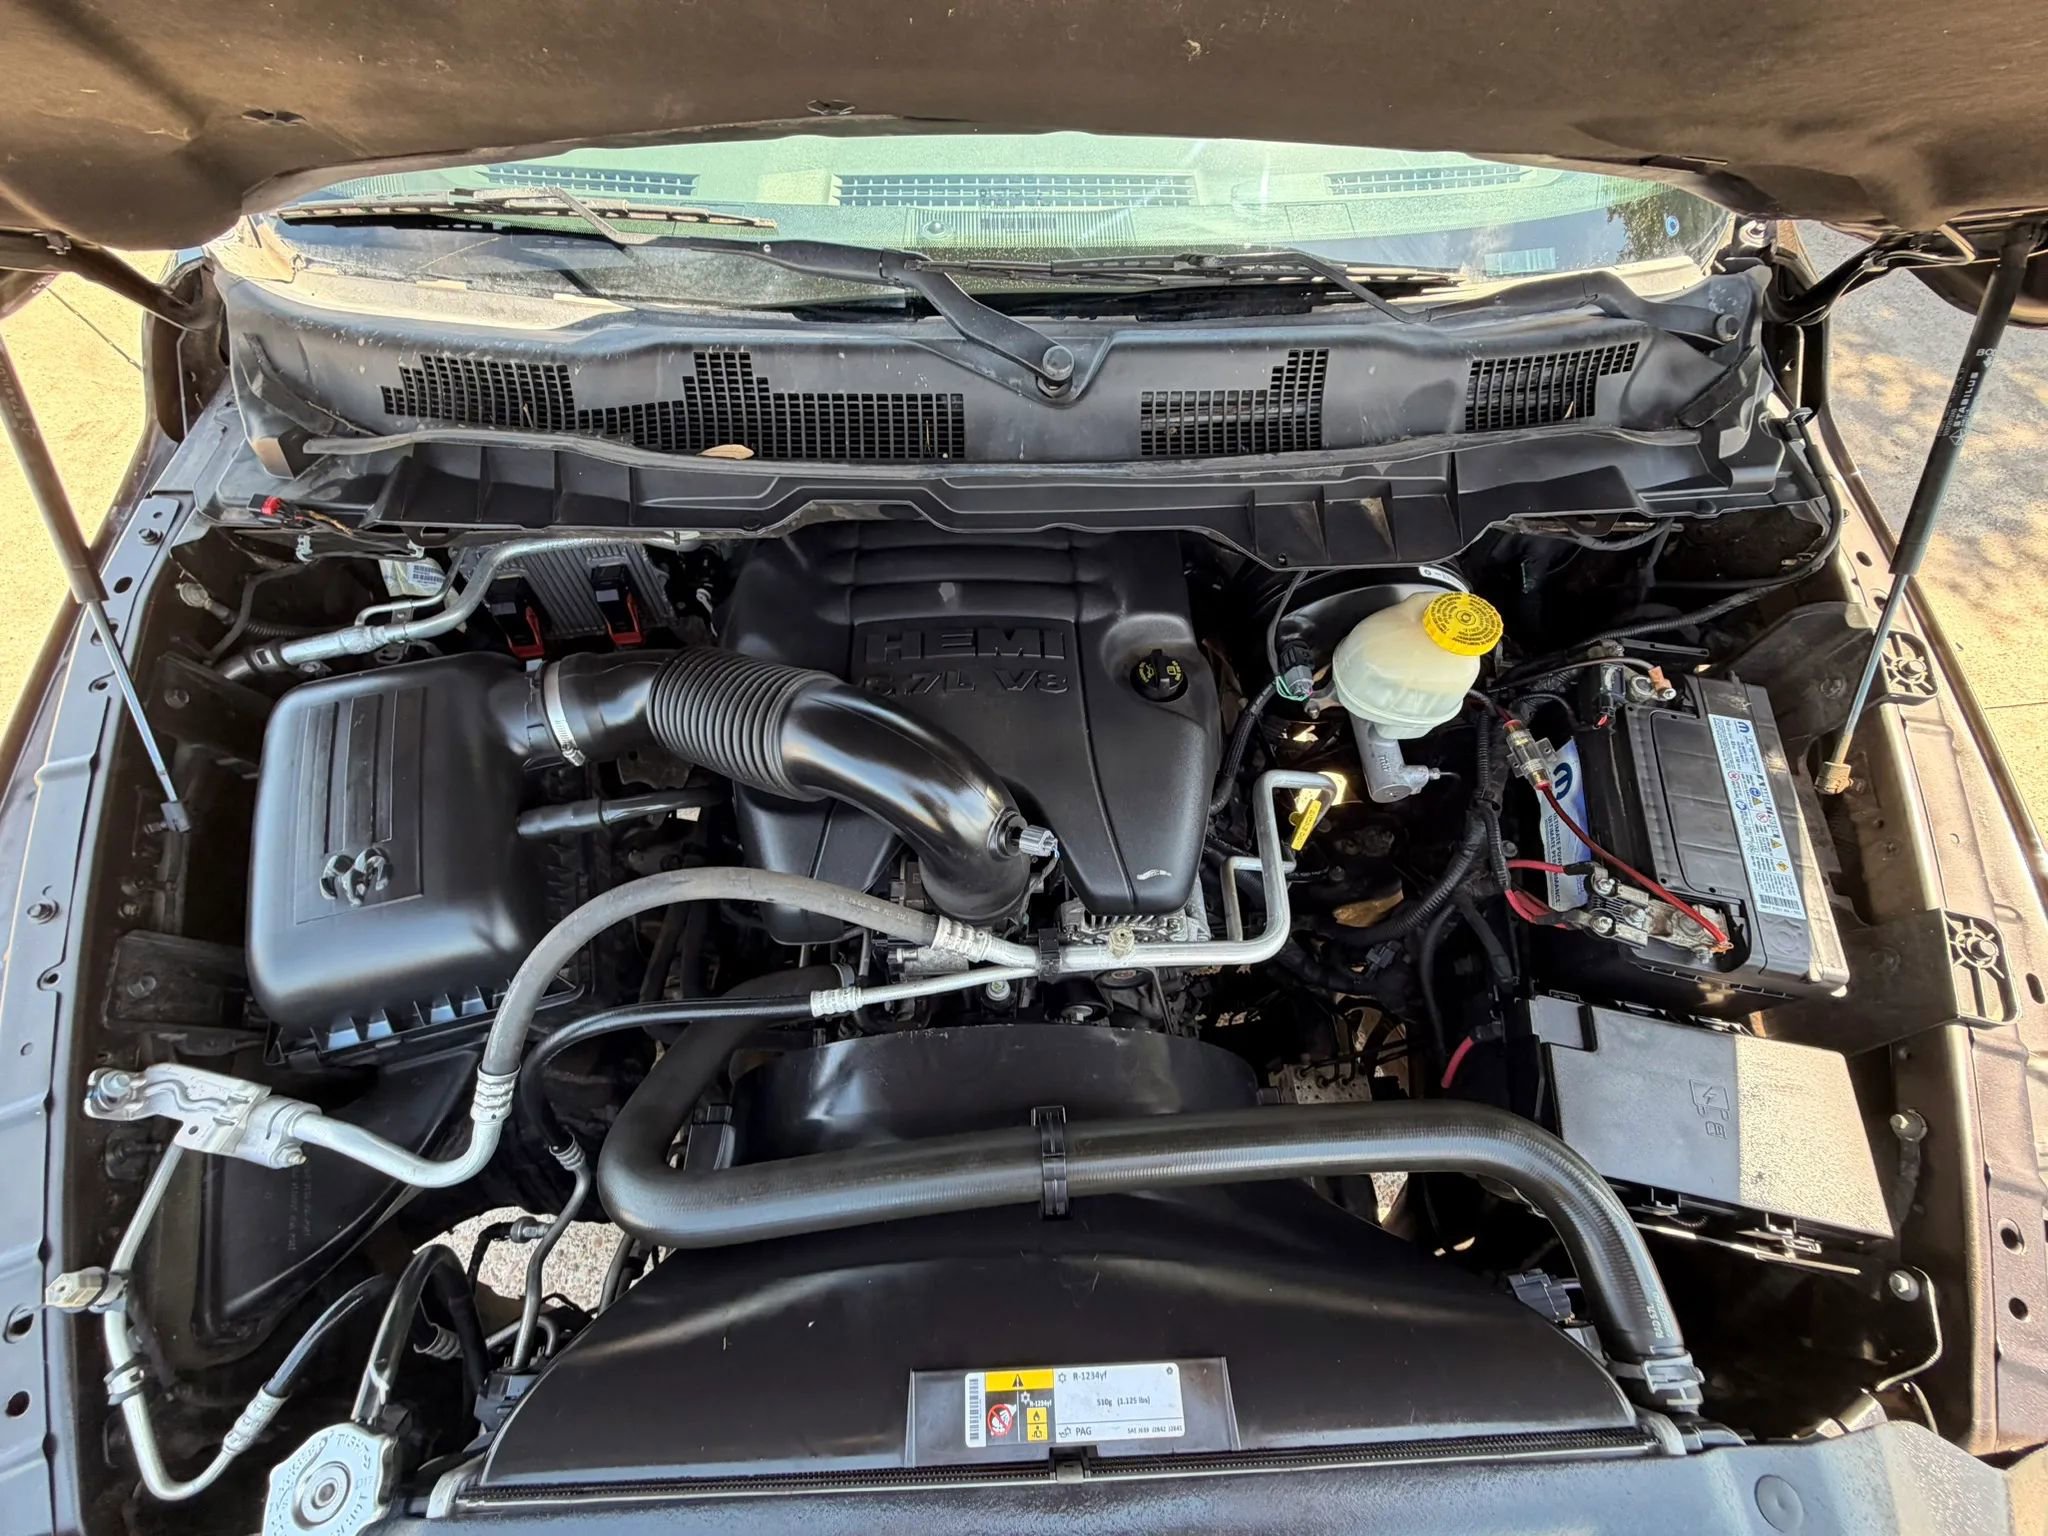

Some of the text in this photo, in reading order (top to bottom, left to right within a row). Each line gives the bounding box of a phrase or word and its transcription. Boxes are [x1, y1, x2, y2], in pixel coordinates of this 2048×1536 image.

[1953, 372, 1979, 427] STABILUS
[866, 628, 1066, 663] HEMI
[992, 669, 1070, 695] V8
[1548, 815, 1556, 848] ULTIMATE
[1073, 1370, 1107, 1382] R-1234yf
[1075, 1426, 1092, 1436] PAG
